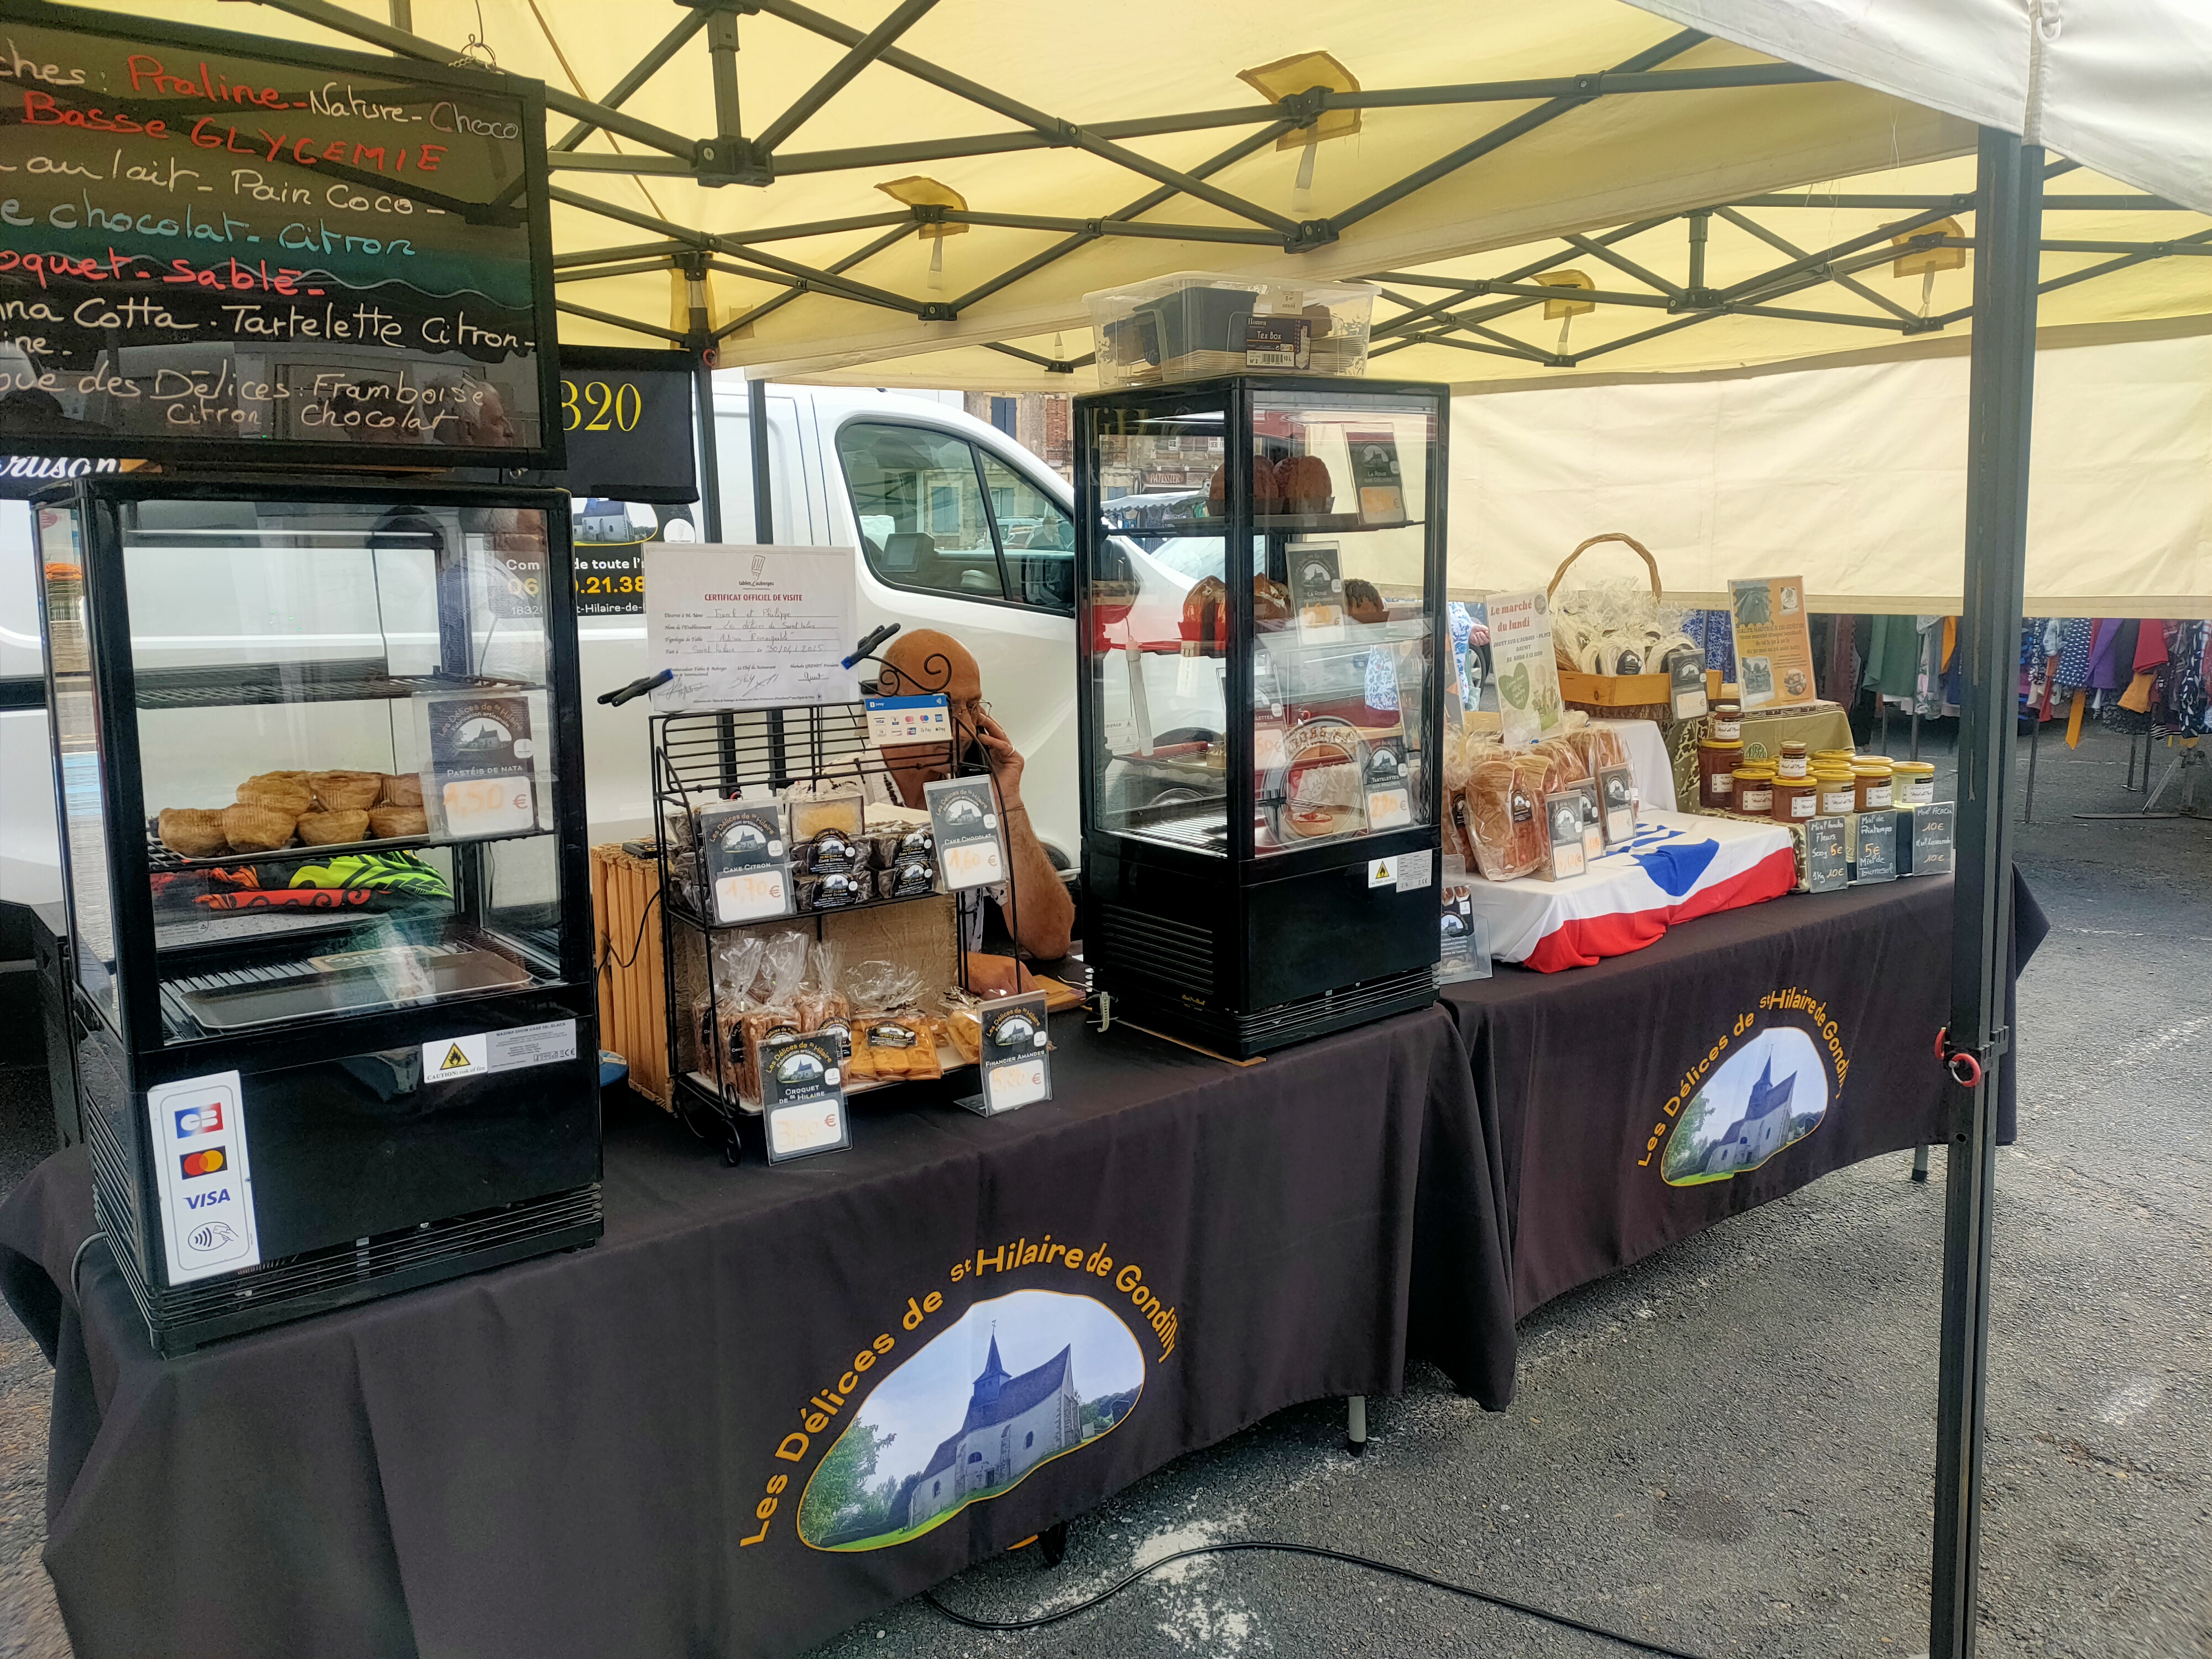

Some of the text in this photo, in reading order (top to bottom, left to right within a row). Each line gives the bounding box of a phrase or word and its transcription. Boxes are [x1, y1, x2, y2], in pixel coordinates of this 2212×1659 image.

[430, 102, 519, 139] Choco
[22, 91, 448, 171] Basse GLYCEMIE
[231, 169, 311, 205] Pain
[279, 218, 415, 255] Citron
[221, 302, 406, 348] Tartelette
[1248, 317, 1266, 326] Homea
[1256, 330, 1282, 340] Tex Box
[78, 359, 142, 397] des
[313, 370, 484, 406] Framboise
[167, 397, 460, 431] Citron Chocolat
[592, 559, 630, 570] toute
[575, 576, 645, 594] .21.38
[1490, 599, 1532, 616] Le marché
[1498, 617, 1530, 632] du lundi
[448, 703, 479, 722] Délices
[481, 702, 492, 711] de
[500, 709, 524, 732] Hilaire
[451, 711, 510, 732] Fabrication artisanale
[513, 794, 528, 810] €
[941, 790, 959, 805] Délices
[972, 792, 988, 810] Hilaire
[1861, 814, 1885, 825] Miel de
[1917, 806, 1953, 817] Miel Acacia
[708, 830, 719, 843] Les
[717, 814, 740, 830] Délices
[755, 816, 775, 835] Hilaire
[719, 820, 764, 838] Fabrication artisanale
[1861, 824, 1892, 834] Printemps
[1922, 822, 1945, 832] 10€
[1865, 843, 1881, 858] 5€
[1923, 854, 1945, 863] 10€
[987, 854, 998, 867] €
[1860, 854, 1886, 867] Miel de
[1826, 868, 1844, 879] 10€
[1859, 862, 1893, 877] Tournesol
[768, 885, 781, 898] €
[985, 1025, 996, 1038] Les
[994, 1009, 1014, 1025] Délices
[1026, 1010, 1041, 1027] Hilaire
[765, 1059, 777, 1074] Les
[774, 1044, 797, 1060] Délices
[799, 1040, 808, 1048] de
[813, 1045, 832, 1063] Hilaire
[776, 1049, 822, 1068] Fabrication artisanale
[985, 1050, 1045, 1068] FINANCIER AMANDES
[427, 1071, 459, 1081] CAUTION:
[1031, 1072, 1042, 1086] €
[1637, 1121, 1667, 1167] Les
[1663, 1034, 1729, 1118] Délices
[1733, 1011, 1755, 1037] de
[1768, 986, 1817, 1014] Hilaire
[1813, 1001, 1827, 1027] de
[785, 1084, 820, 1095] CROQUET
[824, 1114, 837, 1128] €
[182, 1188, 231, 1210] VISA
[739, 1474, 788, 1548] Les
[775, 1332, 896, 1464] Délices
[902, 1289, 943, 1331] de
[975, 1234, 1084, 1277] Hilaire
[1086, 1242, 1113, 1277] de
[1115, 1264, 1178, 1364] Gondilly
